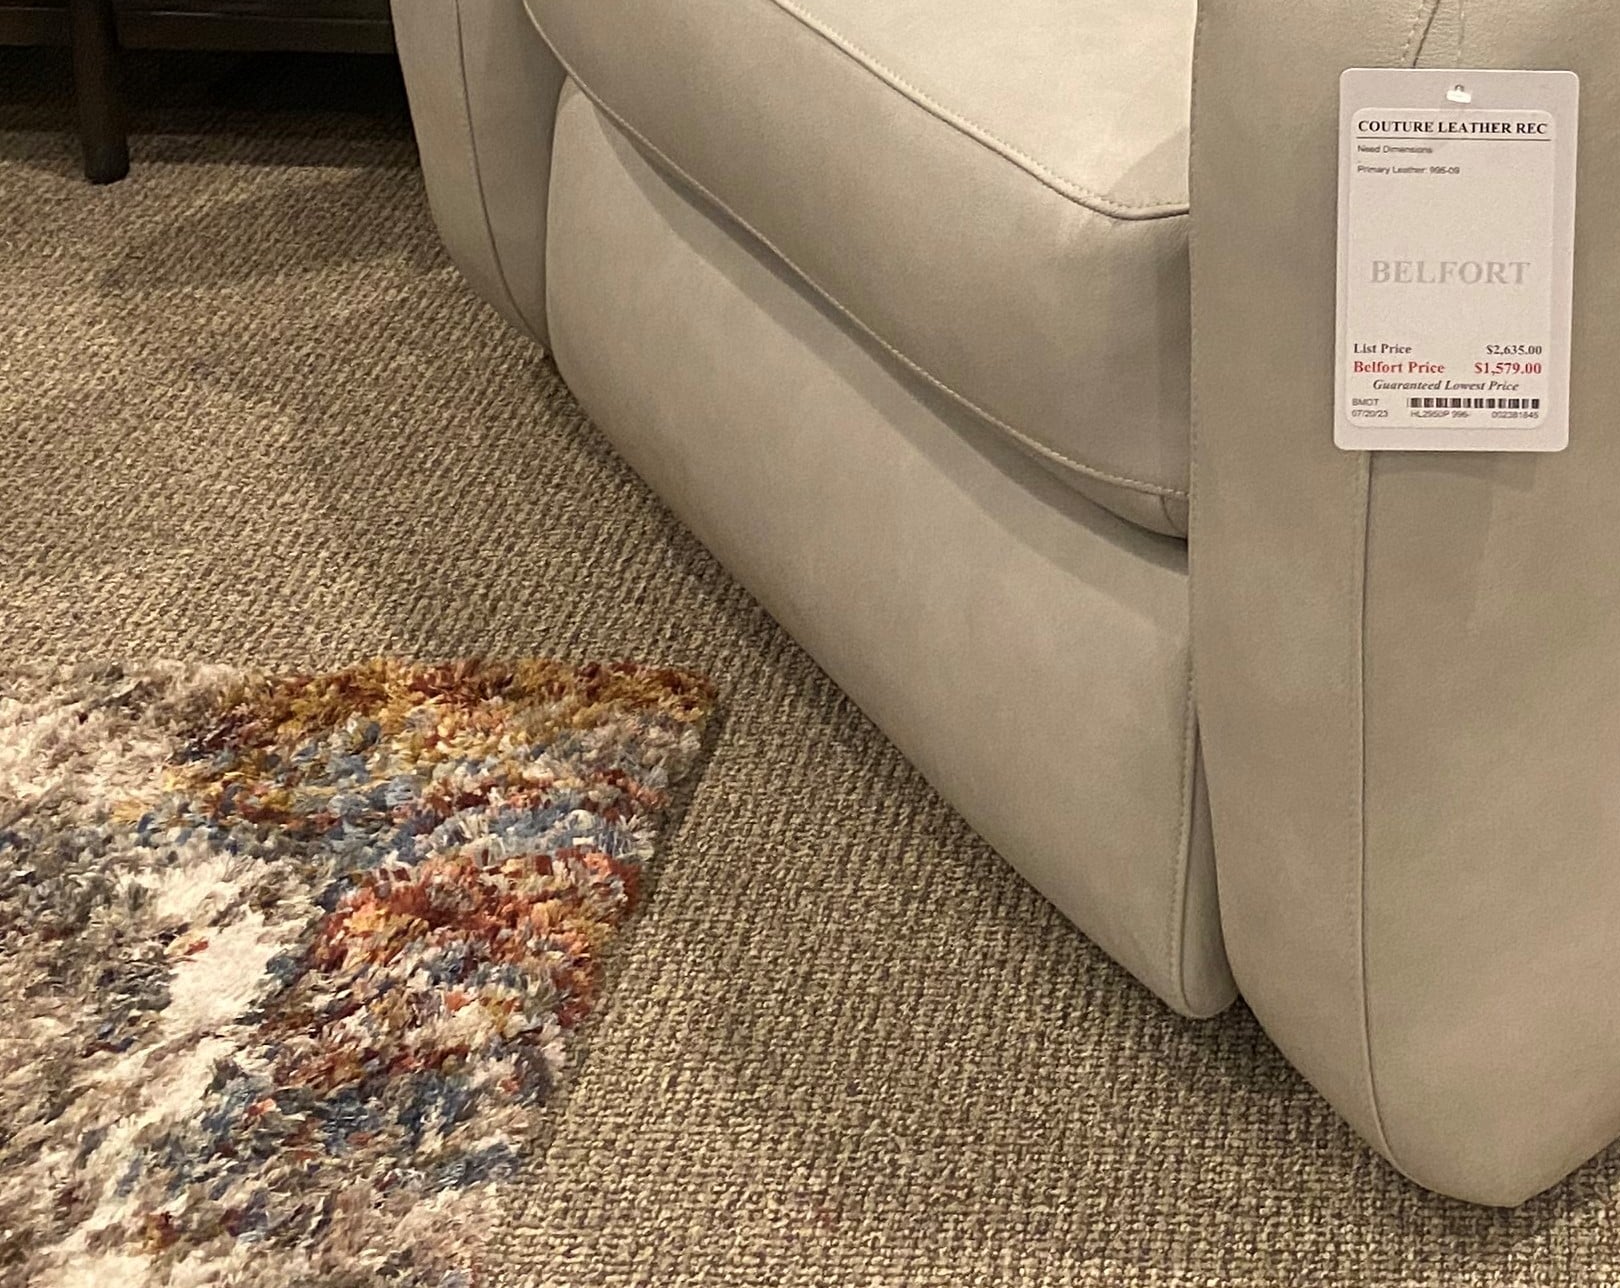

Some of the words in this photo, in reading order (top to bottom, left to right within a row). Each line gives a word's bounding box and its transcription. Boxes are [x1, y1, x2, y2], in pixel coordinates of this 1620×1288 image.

[1357, 120, 1434, 133] COUTURE
[1437, 121, 1512, 135] LEATHER
[1515, 122, 1549, 135] REC
[1371, 260, 1530, 285] BELFORT
[1353, 343, 1377, 354] List
[1379, 344, 1413, 354] Price
[1486, 345, 1542, 356] $2,635.00
[1353, 361, 1403, 374] Belfort
[1408, 362, 1446, 374] Price
[1474, 362, 1542, 376] $1,579.00
[1372, 379, 1441, 391] Guaranteed
[1444, 380, 1486, 391] Lowest
[1488, 381, 1520, 392] Price
